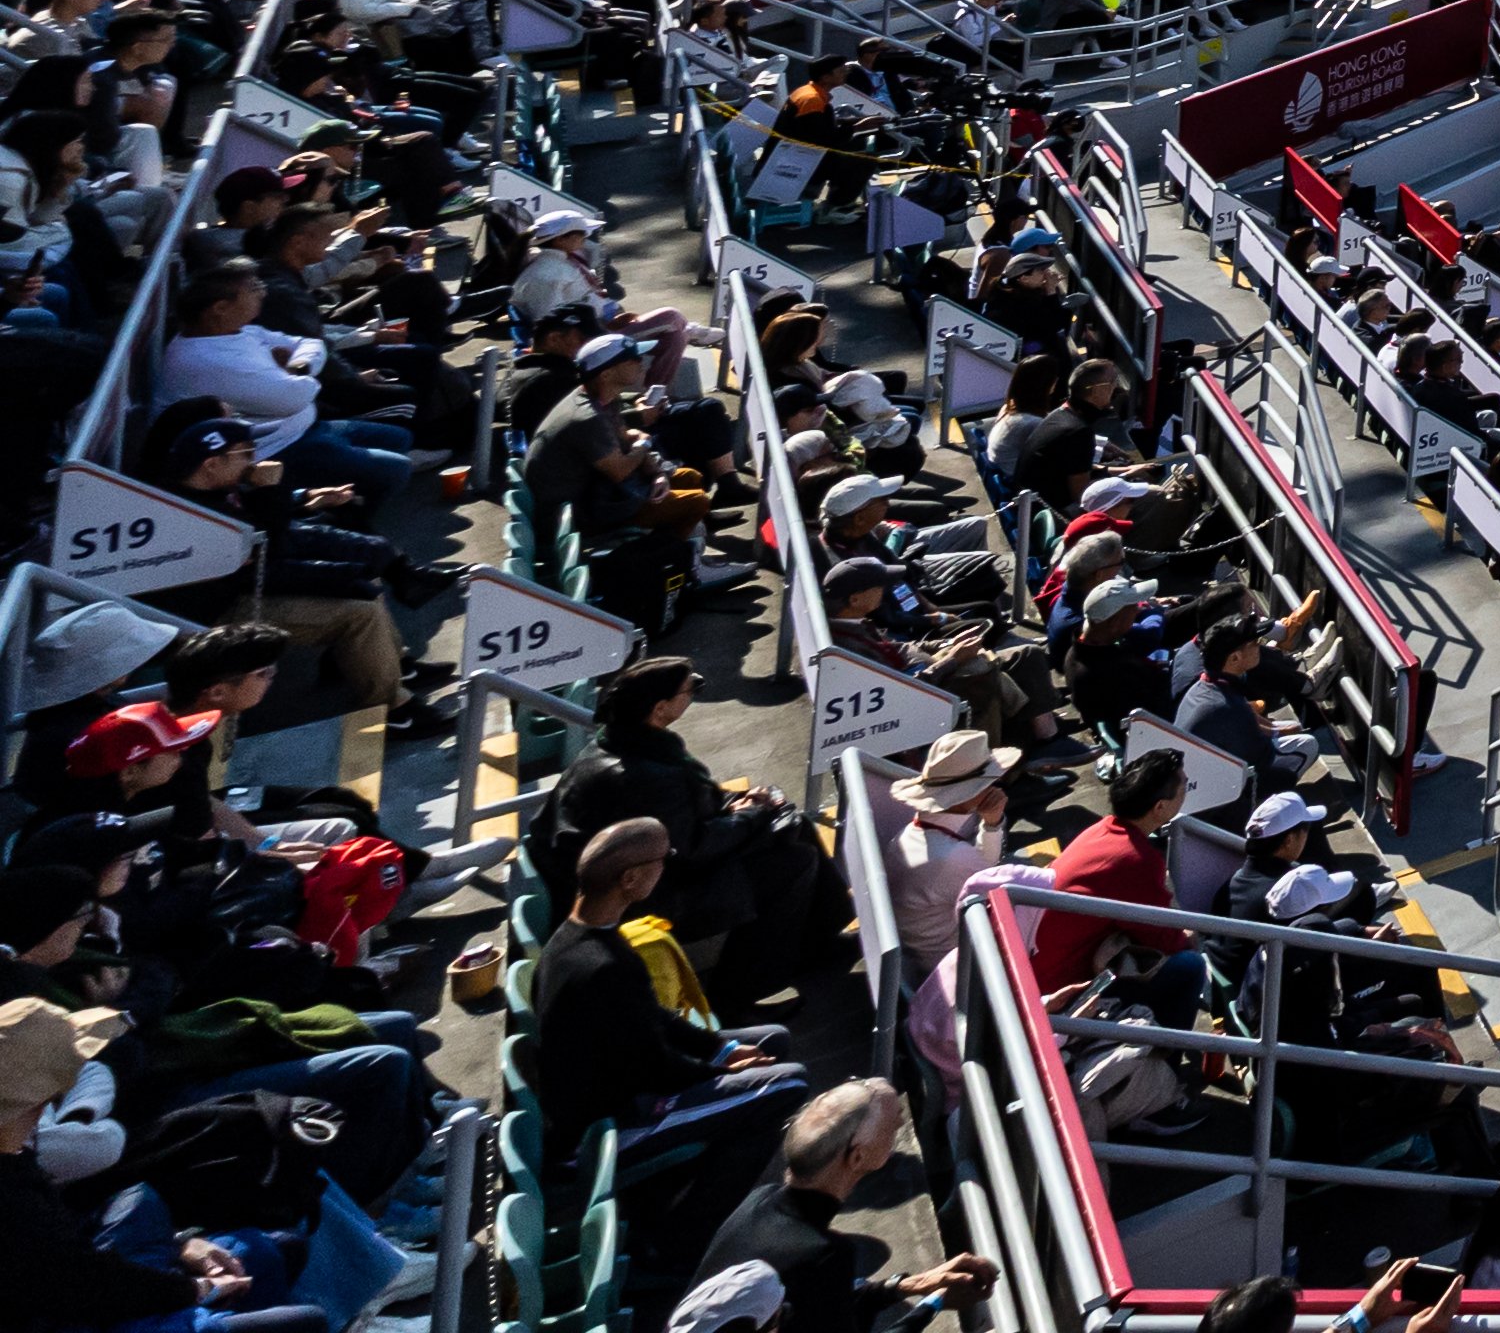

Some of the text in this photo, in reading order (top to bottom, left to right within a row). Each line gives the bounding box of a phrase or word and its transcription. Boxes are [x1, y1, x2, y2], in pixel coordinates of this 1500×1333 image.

[1328, 40, 1407, 82] HONG KONG
[1328, 58, 1406, 96] TOURISM BOARD
[1419, 432, 1438, 450] S6
[70, 517, 156, 561] S19
[122, 546, 193, 571] Hospital
[479, 621, 550, 661] S19
[523, 646, 583, 671] Hospital
[825, 687, 886, 726] S13
[821, 719, 901, 750] JAMES TIEN
